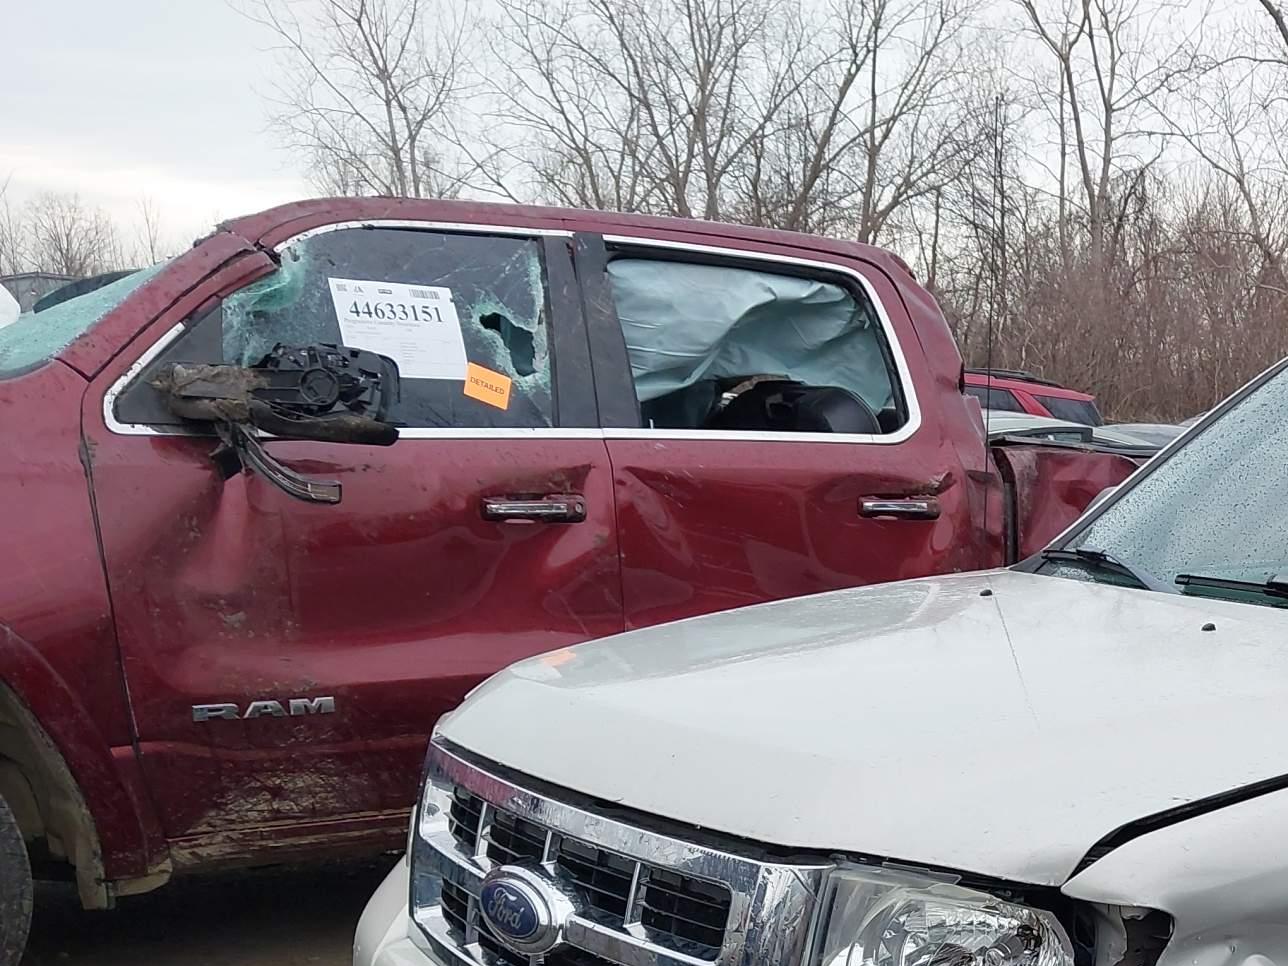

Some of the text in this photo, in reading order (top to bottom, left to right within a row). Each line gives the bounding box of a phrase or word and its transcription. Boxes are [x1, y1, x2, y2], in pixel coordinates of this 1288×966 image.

[349, 300, 443, 322] 44633151
[470, 377, 504, 394] DETAILED
[192, 696, 335, 722] RAM
[488, 887, 525, 929] Ford
